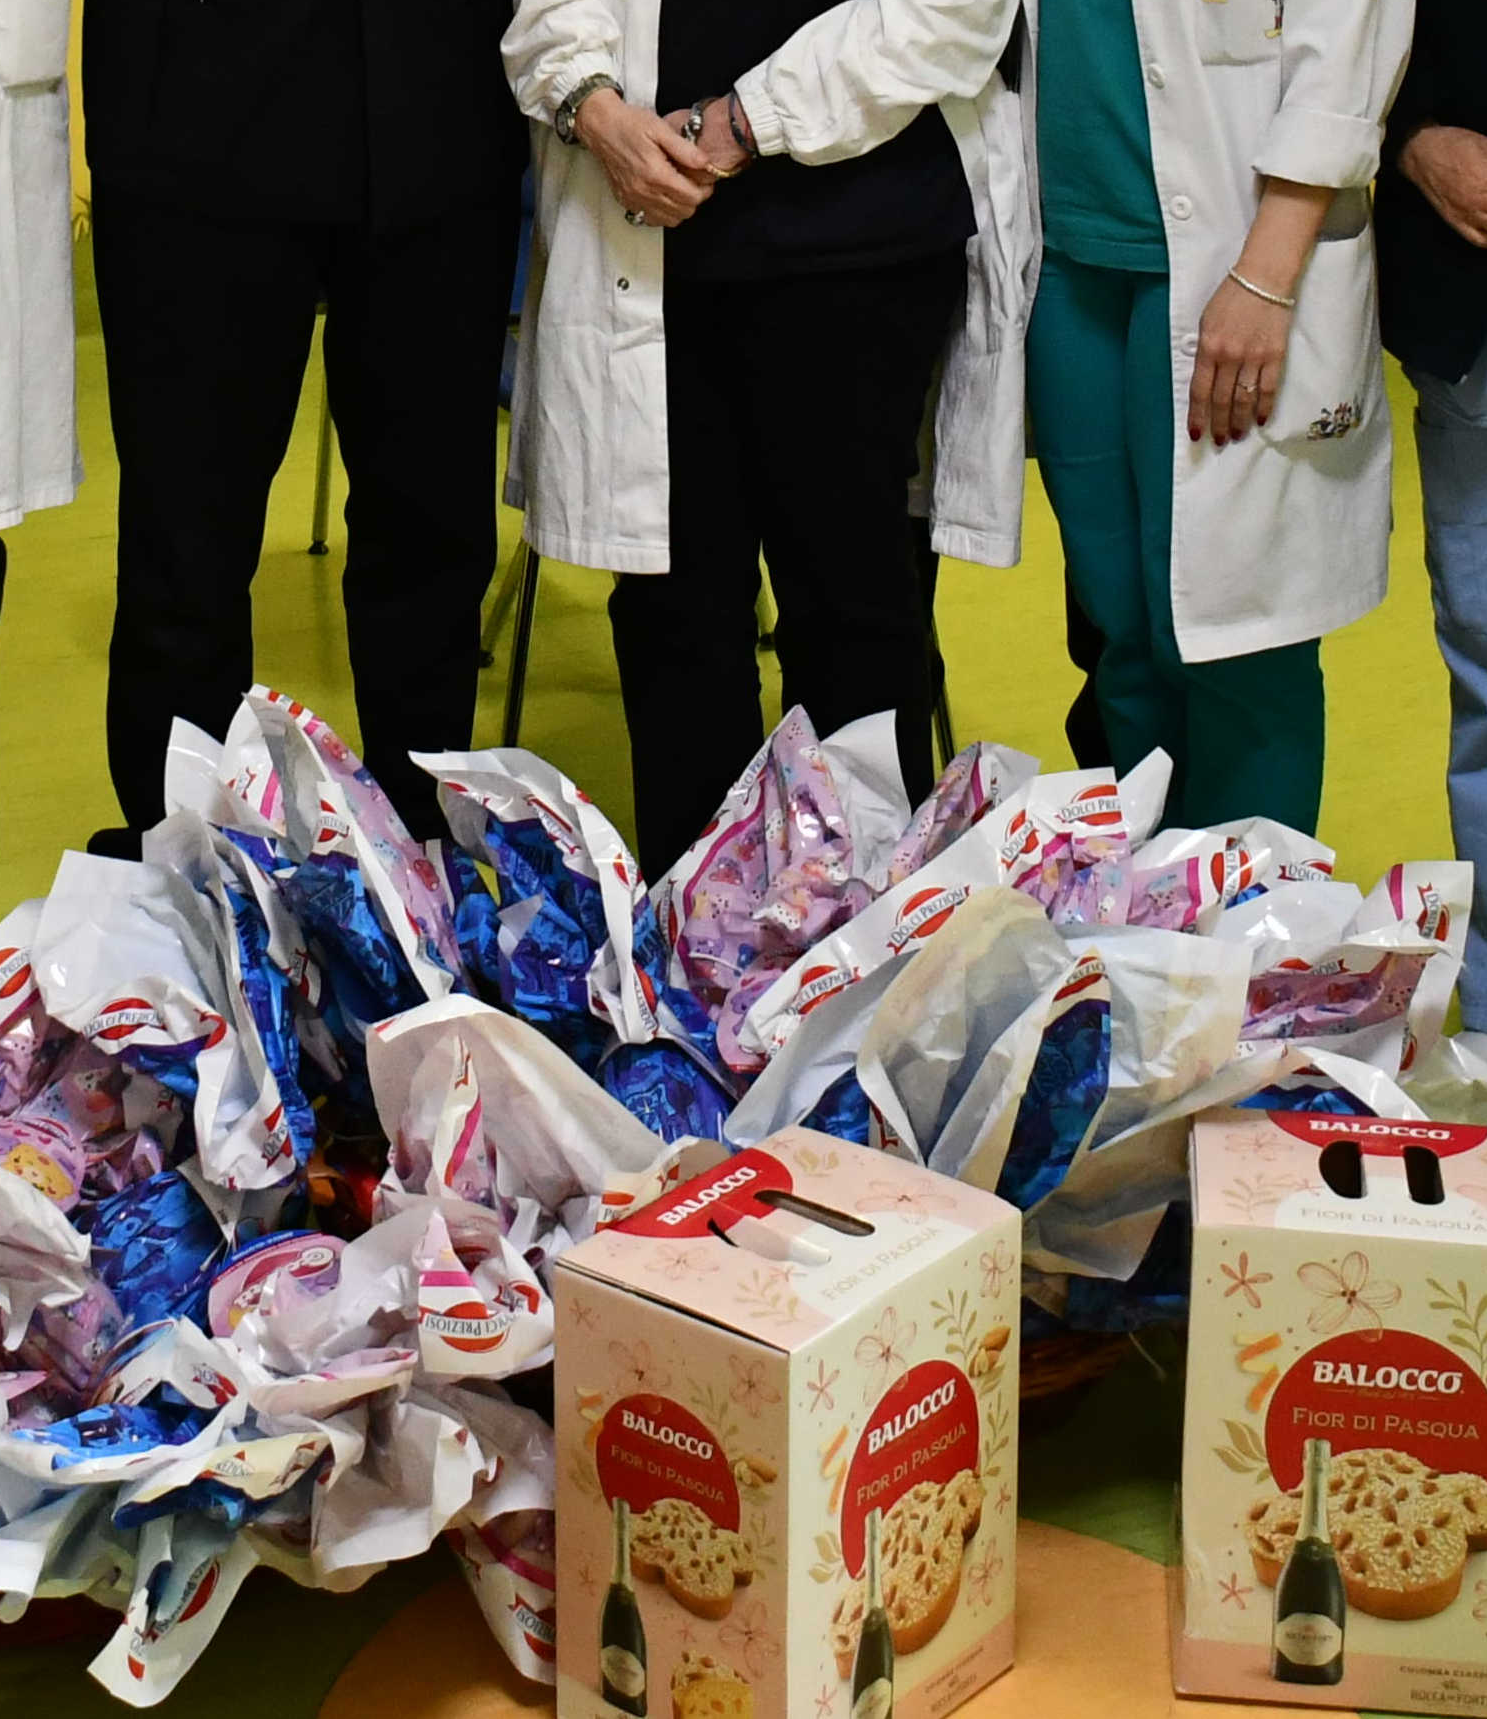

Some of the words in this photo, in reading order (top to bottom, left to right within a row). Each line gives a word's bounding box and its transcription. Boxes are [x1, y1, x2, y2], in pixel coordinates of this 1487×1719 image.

[1308, 1119, 1451, 1141] BALOCCO
[656, 1166, 758, 1226] BALOCCO
[1301, 1207, 1353, 1223] FIOR
[1361, 1211, 1384, 1224] DI
[424, 1315, 483, 1337] PREZIOSI
[1312, 1359, 1464, 1395] BALOCCO
[621, 1409, 714, 1461] BALOCCO
[866, 1378, 957, 1456] BALOCCO
[1292, 1406, 1346, 1429] FIOR
[1353, 1414, 1376, 1432] DI
[1384, 1413, 1480, 1440] PASQUA
[856, 1473, 891, 1508] FIOR
[893, 1460, 909, 1483] DI
[910, 1422, 968, 1471] PASQUA
[665, 1466, 726, 1504] PASQUA
